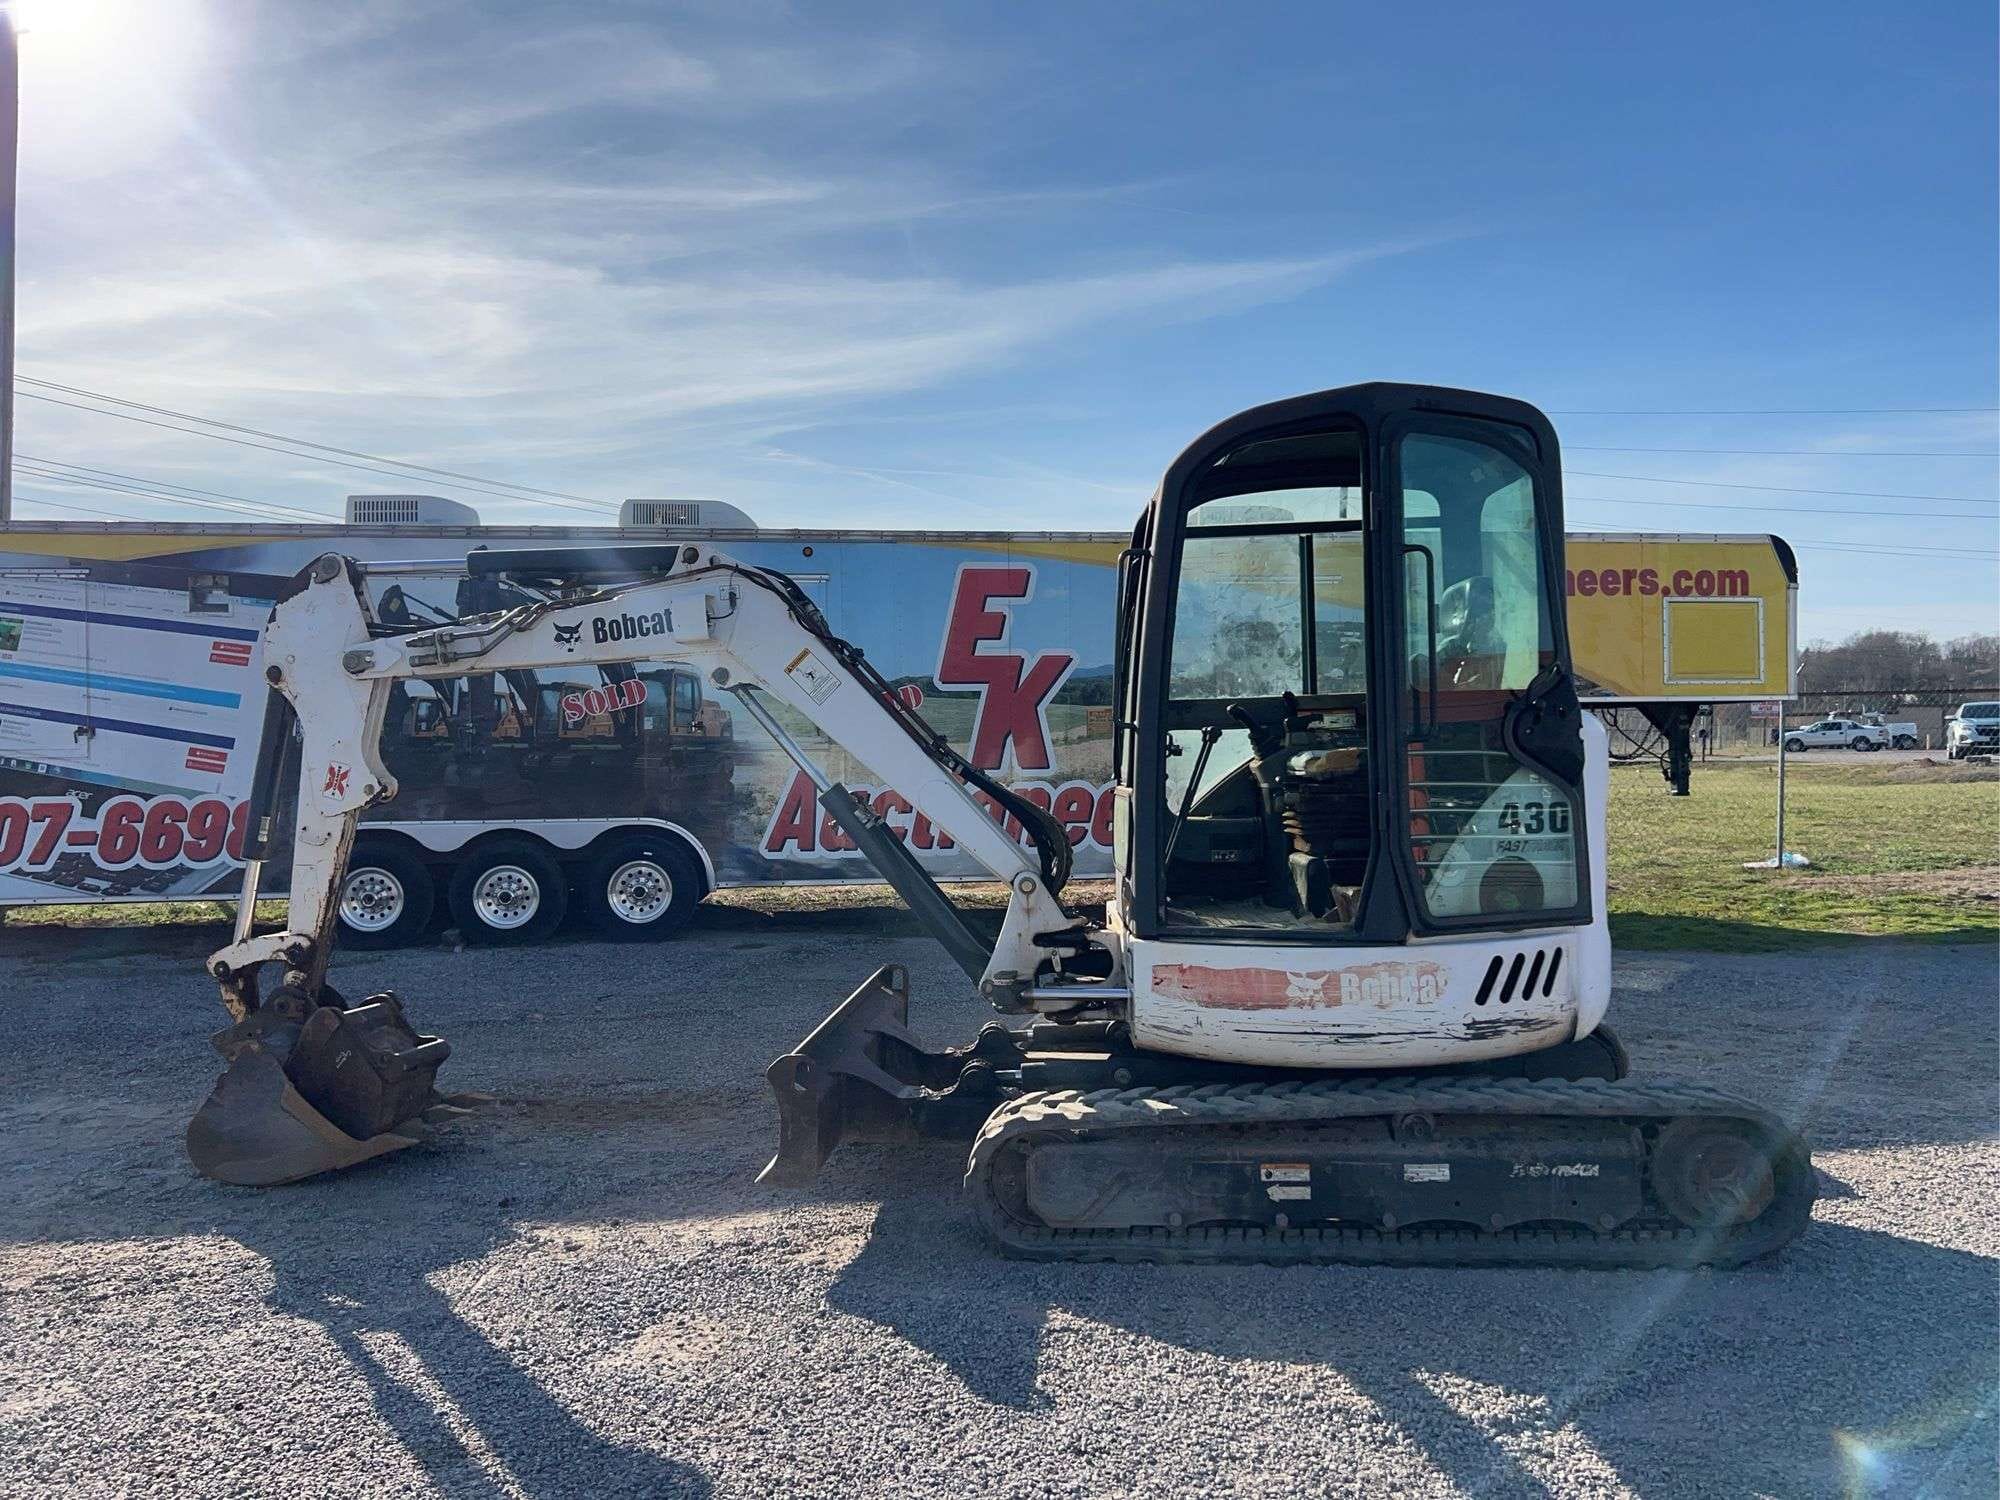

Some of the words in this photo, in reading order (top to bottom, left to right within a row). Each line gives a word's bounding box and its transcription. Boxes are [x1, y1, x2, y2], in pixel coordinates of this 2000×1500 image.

[592, 608, 674, 644] Bobcat
[562, 679, 648, 722] SOLD
[65, 788, 94, 801] acer
[1498, 802, 1569, 834] 430
[1496, 839, 1529, 853] FAST
